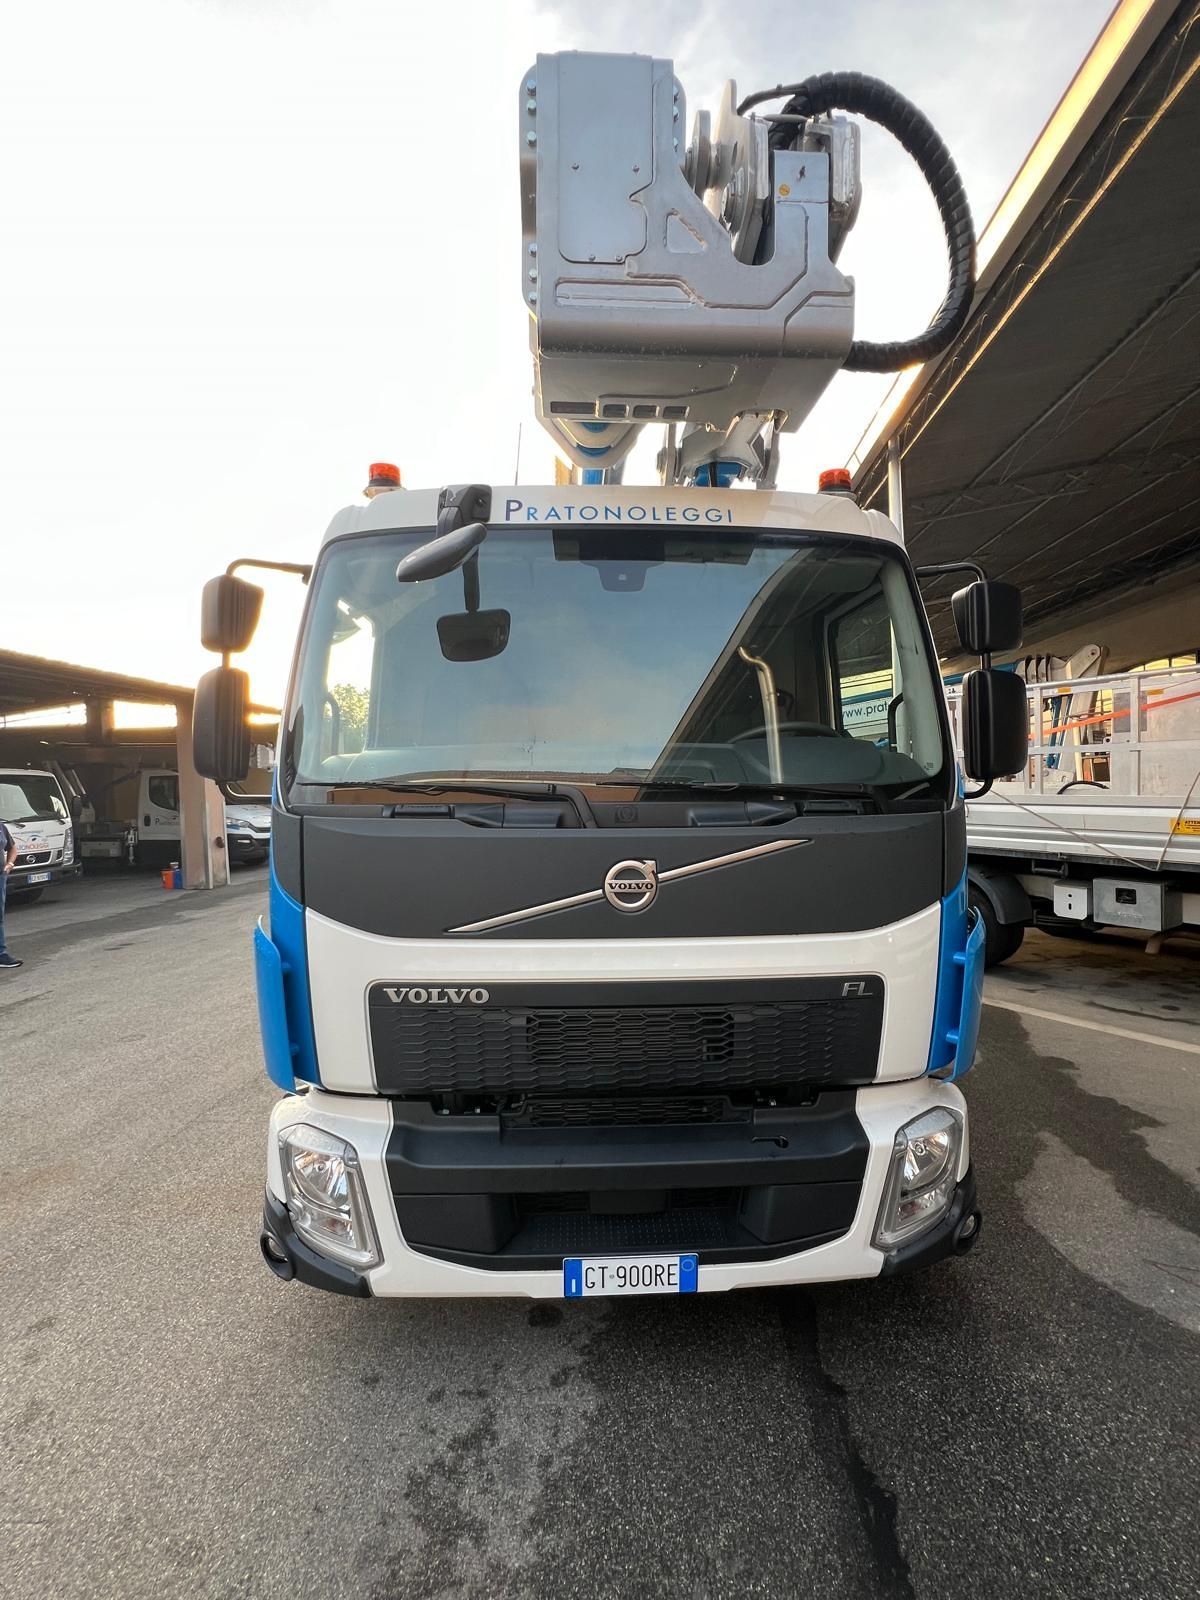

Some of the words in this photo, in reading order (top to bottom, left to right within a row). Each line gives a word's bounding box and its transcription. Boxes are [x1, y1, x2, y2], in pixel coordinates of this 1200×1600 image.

[607, 882, 654, 890] VOLVO
[383, 987, 490, 1004] VOLVO
[841, 981, 873, 997] FL
[585, 1266, 609, 1289] GT
